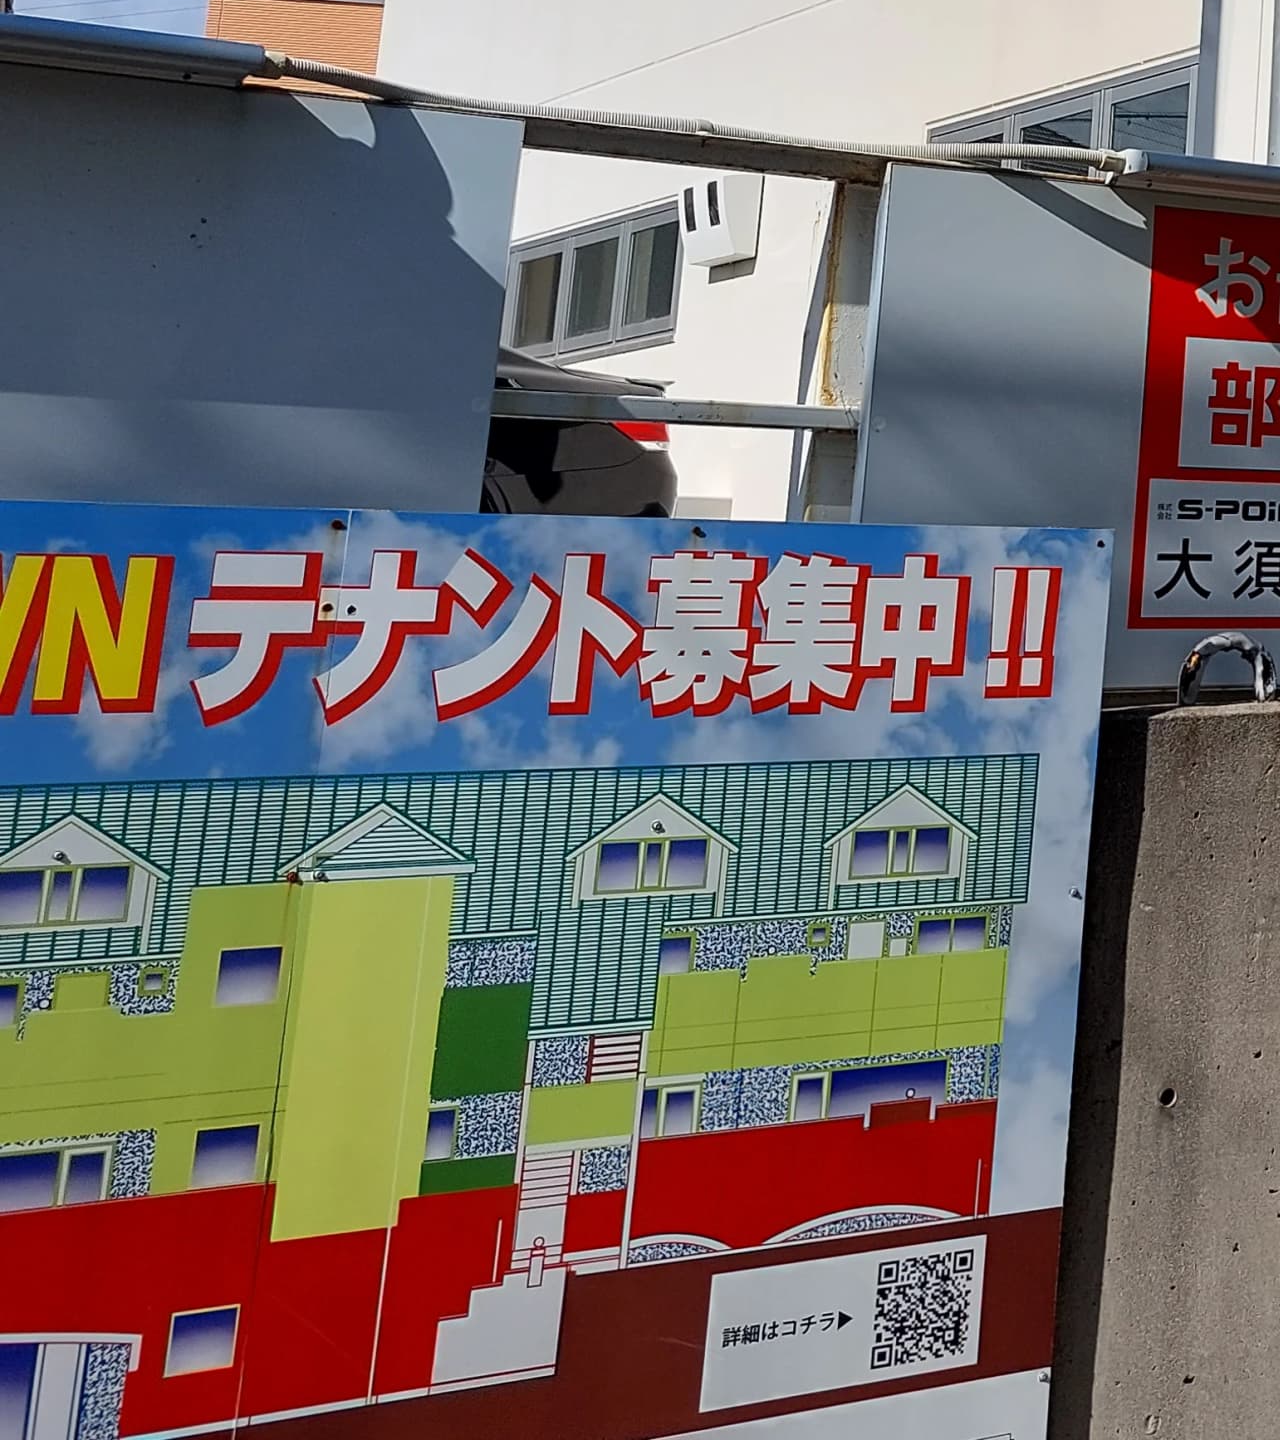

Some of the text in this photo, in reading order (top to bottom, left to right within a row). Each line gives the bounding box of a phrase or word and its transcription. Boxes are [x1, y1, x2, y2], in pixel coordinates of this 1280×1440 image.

[721, 1311, 838, 1348] 詳細はコチラ
